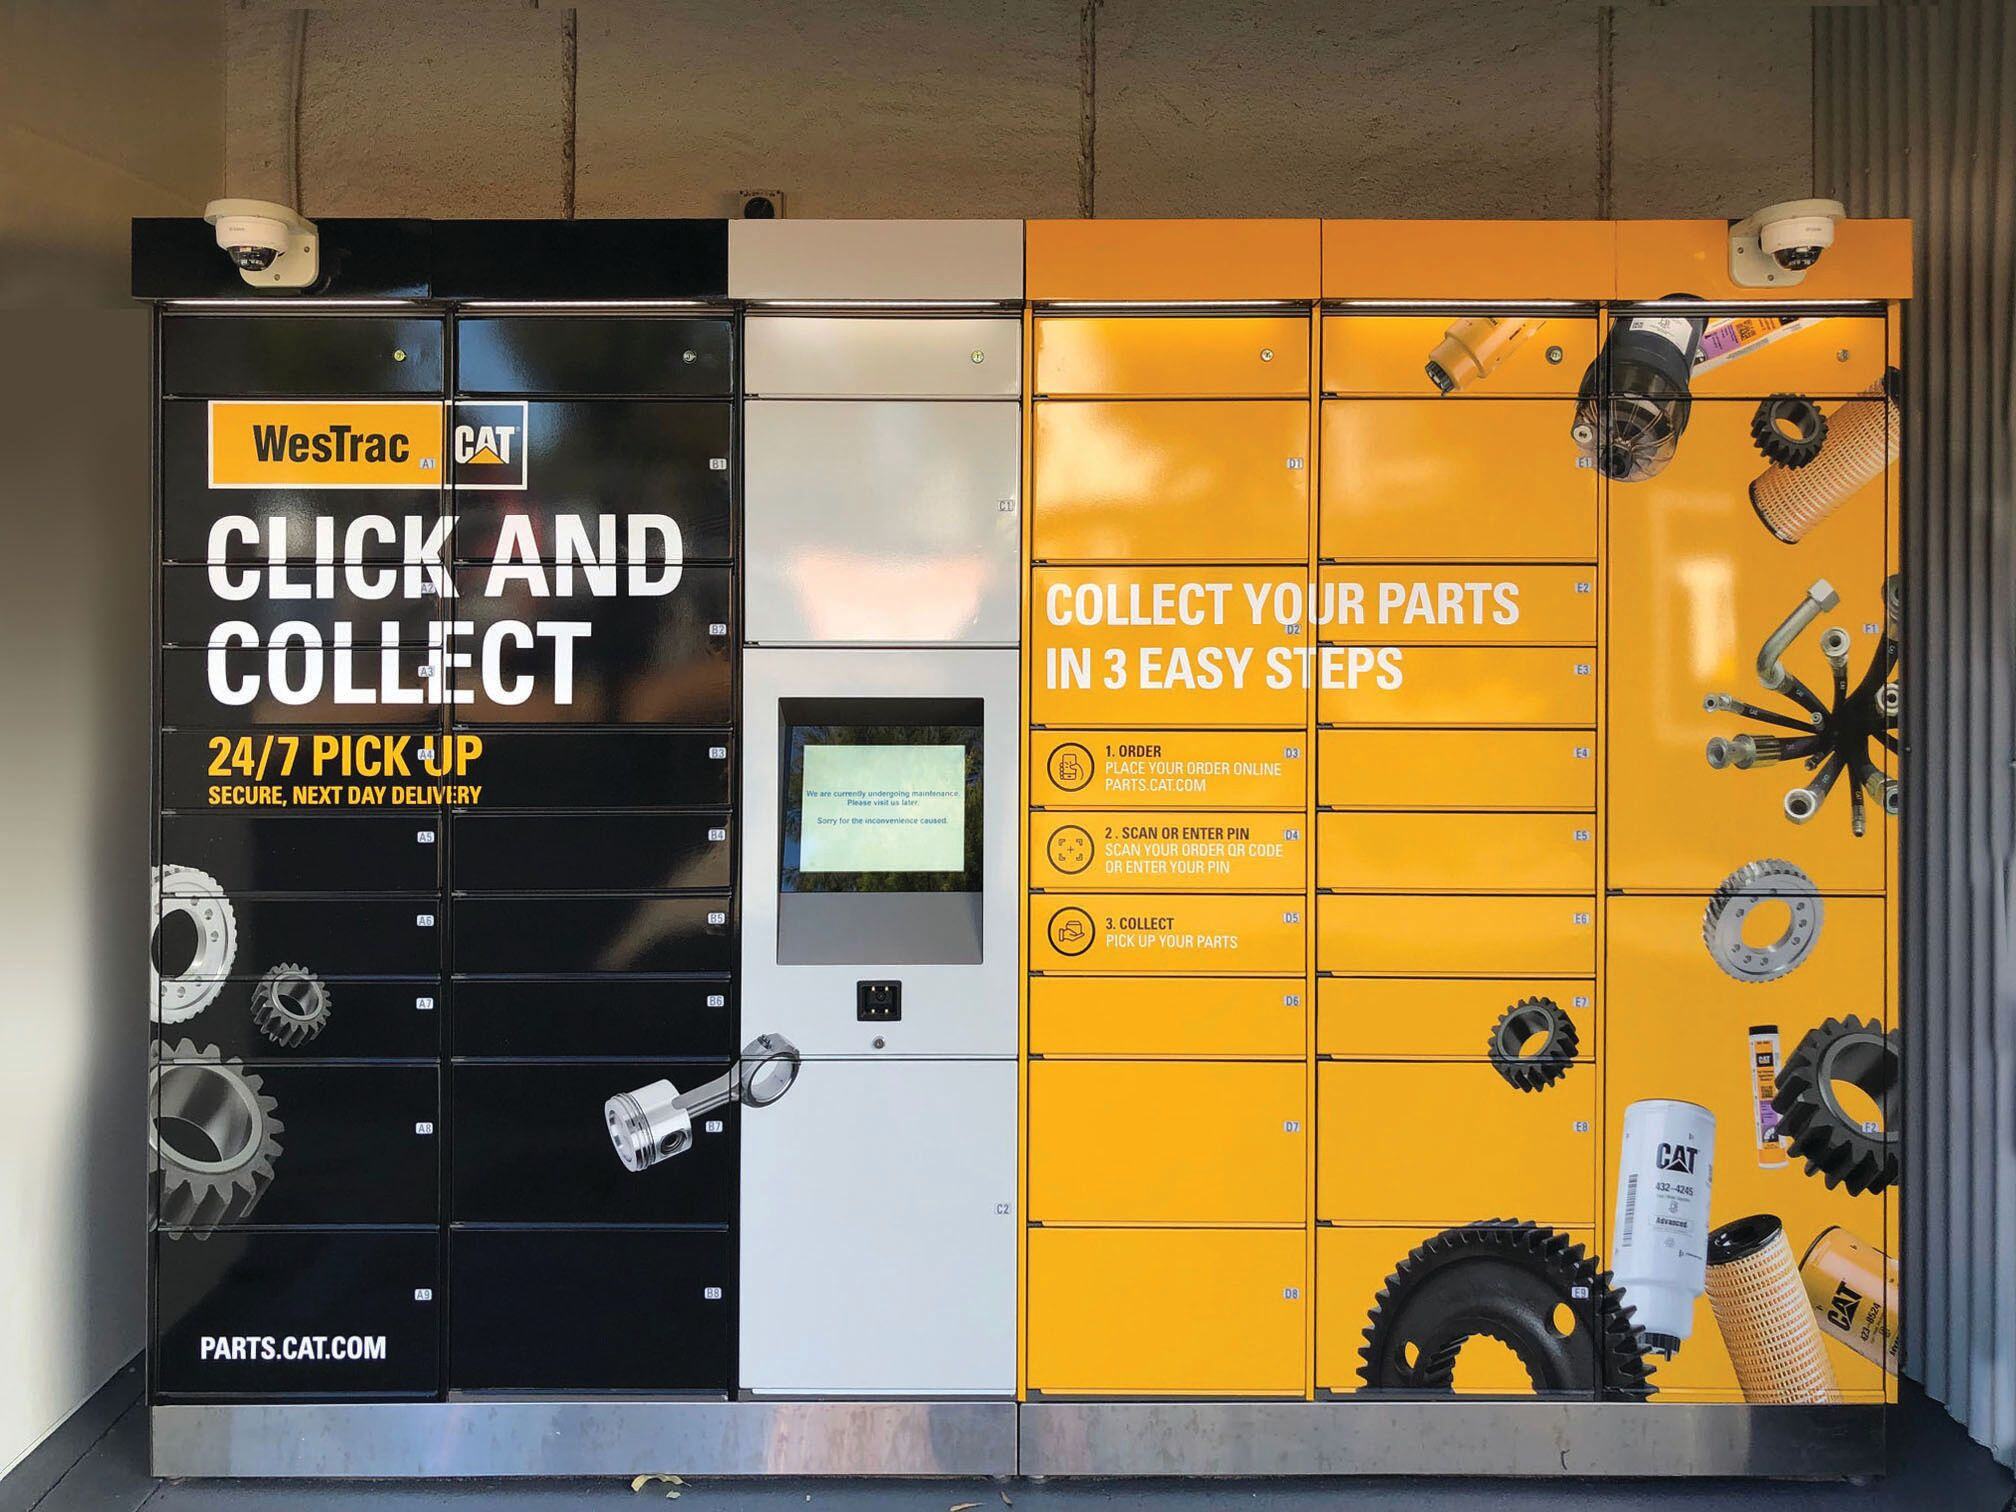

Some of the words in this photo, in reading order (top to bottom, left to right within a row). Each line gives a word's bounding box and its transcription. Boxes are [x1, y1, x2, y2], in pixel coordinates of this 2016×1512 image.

[253, 424, 410, 463] WesTrac
[454, 424, 516, 464] CAT
[422, 459, 434, 468] A1
[712, 460, 724, 469] B1
[1289, 458, 1301, 468] D1
[1578, 458, 1590, 468] E1
[999, 501, 1012, 511] C1
[207, 514, 461, 600] CLICK
[484, 513, 684, 598] AND
[421, 583, 433, 593] A2
[1577, 583, 1589, 593] E2
[1045, 582, 1233, 627] COLLECT
[1242, 582, 1365, 627] YOUR
[1379, 581, 1520, 626] PARTS
[712, 625, 725, 634] B2
[1287, 625, 1300, 635] D2
[1865, 623, 1877, 633] F1
[207, 620, 592, 706] COLLECT
[420, 666, 433, 676] A3
[1046, 647, 1091, 690] IN
[1103, 647, 1127, 690] 3
[1140, 647, 1254, 690] EASY
[1266, 646, 1403, 691] STEPS
[1577, 665, 1589, 675] E3
[420, 749, 432, 759] A4
[712, 749, 724, 758] B3
[1105, 745, 1115, 758] 1.
[1119, 745, 1162, 758] ORDER
[1286, 748, 1298, 758] D3
[1576, 748, 1588, 759] E4
[207, 735, 300, 782] 24/7
[312, 734, 412, 777] PICK
[424, 735, 483, 778] UP
[1105, 761, 1145, 775] PLACE
[1149, 762, 1184, 775] YOUR
[1186, 762, 1230, 775] ORDER
[1233, 762, 1281, 776] ONLINE
[1105, 778, 1206, 792] PARTS.CAT.COM
[207, 785, 288, 807] SECURE,
[292, 785, 344, 805] NEXT
[348, 785, 387, 805] DAY
[391, 785, 483, 805] DELIVERY
[833, 790, 866, 798] currently
[868, 790, 910, 798] undergoing
[817, 817, 837, 826] Sorry
[839, 817, 849, 825] for
[851, 817, 863, 825] the
[864, 817, 918, 825] inconvenience
[919, 817, 949, 825] caused.
[419, 832, 431, 842] A5
[711, 830, 723, 839] B4
[1122, 826, 1158, 840] SCAN
[1161, 827, 1179, 840] OR
[1182, 827, 1224, 840] ENTER
[1227, 827, 1250, 840] PIN
[1285, 830, 1298, 840] D4
[1575, 830, 1588, 840] E5
[1105, 843, 1141, 857] SCAN
[1143, 843, 1178, 857] YOUR
[1182, 843, 1225, 857] ORDER
[1227, 844, 1245, 857] QR
[1248, 843, 1283, 857] CODE
[1105, 860, 1123, 873] OR
[1126, 860, 1167, 873] ENTER
[1169, 860, 1205, 873] YOUR
[1207, 860, 1231, 874] PIN
[419, 916, 432, 925] A6
[710, 914, 723, 923] B5
[1285, 913, 1298, 923] D5
[1575, 914, 1587, 924] E6
[1105, 917, 1116, 930] 3.
[1119, 917, 1175, 930] COLLECT
[1105, 935, 1135, 948] PICK
[1138, 935, 1156, 948] UP
[1159, 935, 1194, 948] YOUR
[1197, 935, 1239, 949] PARTS
[419, 999, 431, 1008] A7
[709, 997, 722, 1006] B6
[1286, 996, 1298, 1006] D6
[1575, 997, 1587, 1007] E7
[418, 1124, 431, 1133] A8
[708, 1122, 721, 1131] B7
[1286, 1122, 1299, 1132] D7
[1576, 1122, 1588, 1132] E8
[1865, 1122, 1877, 1132] F2
[1656, 1142, 1698, 1175] CAT
[996, 1204, 1009, 1214] C2
[417, 1290, 430, 1299] A9
[707, 1289, 719, 1298] B8
[1285, 1289, 1298, 1299] D8
[1575, 1288, 1586, 1298] E9
[1827, 1280, 1863, 1332] CAT
[200, 1336, 387, 1360] PARTS.CAT.COM
